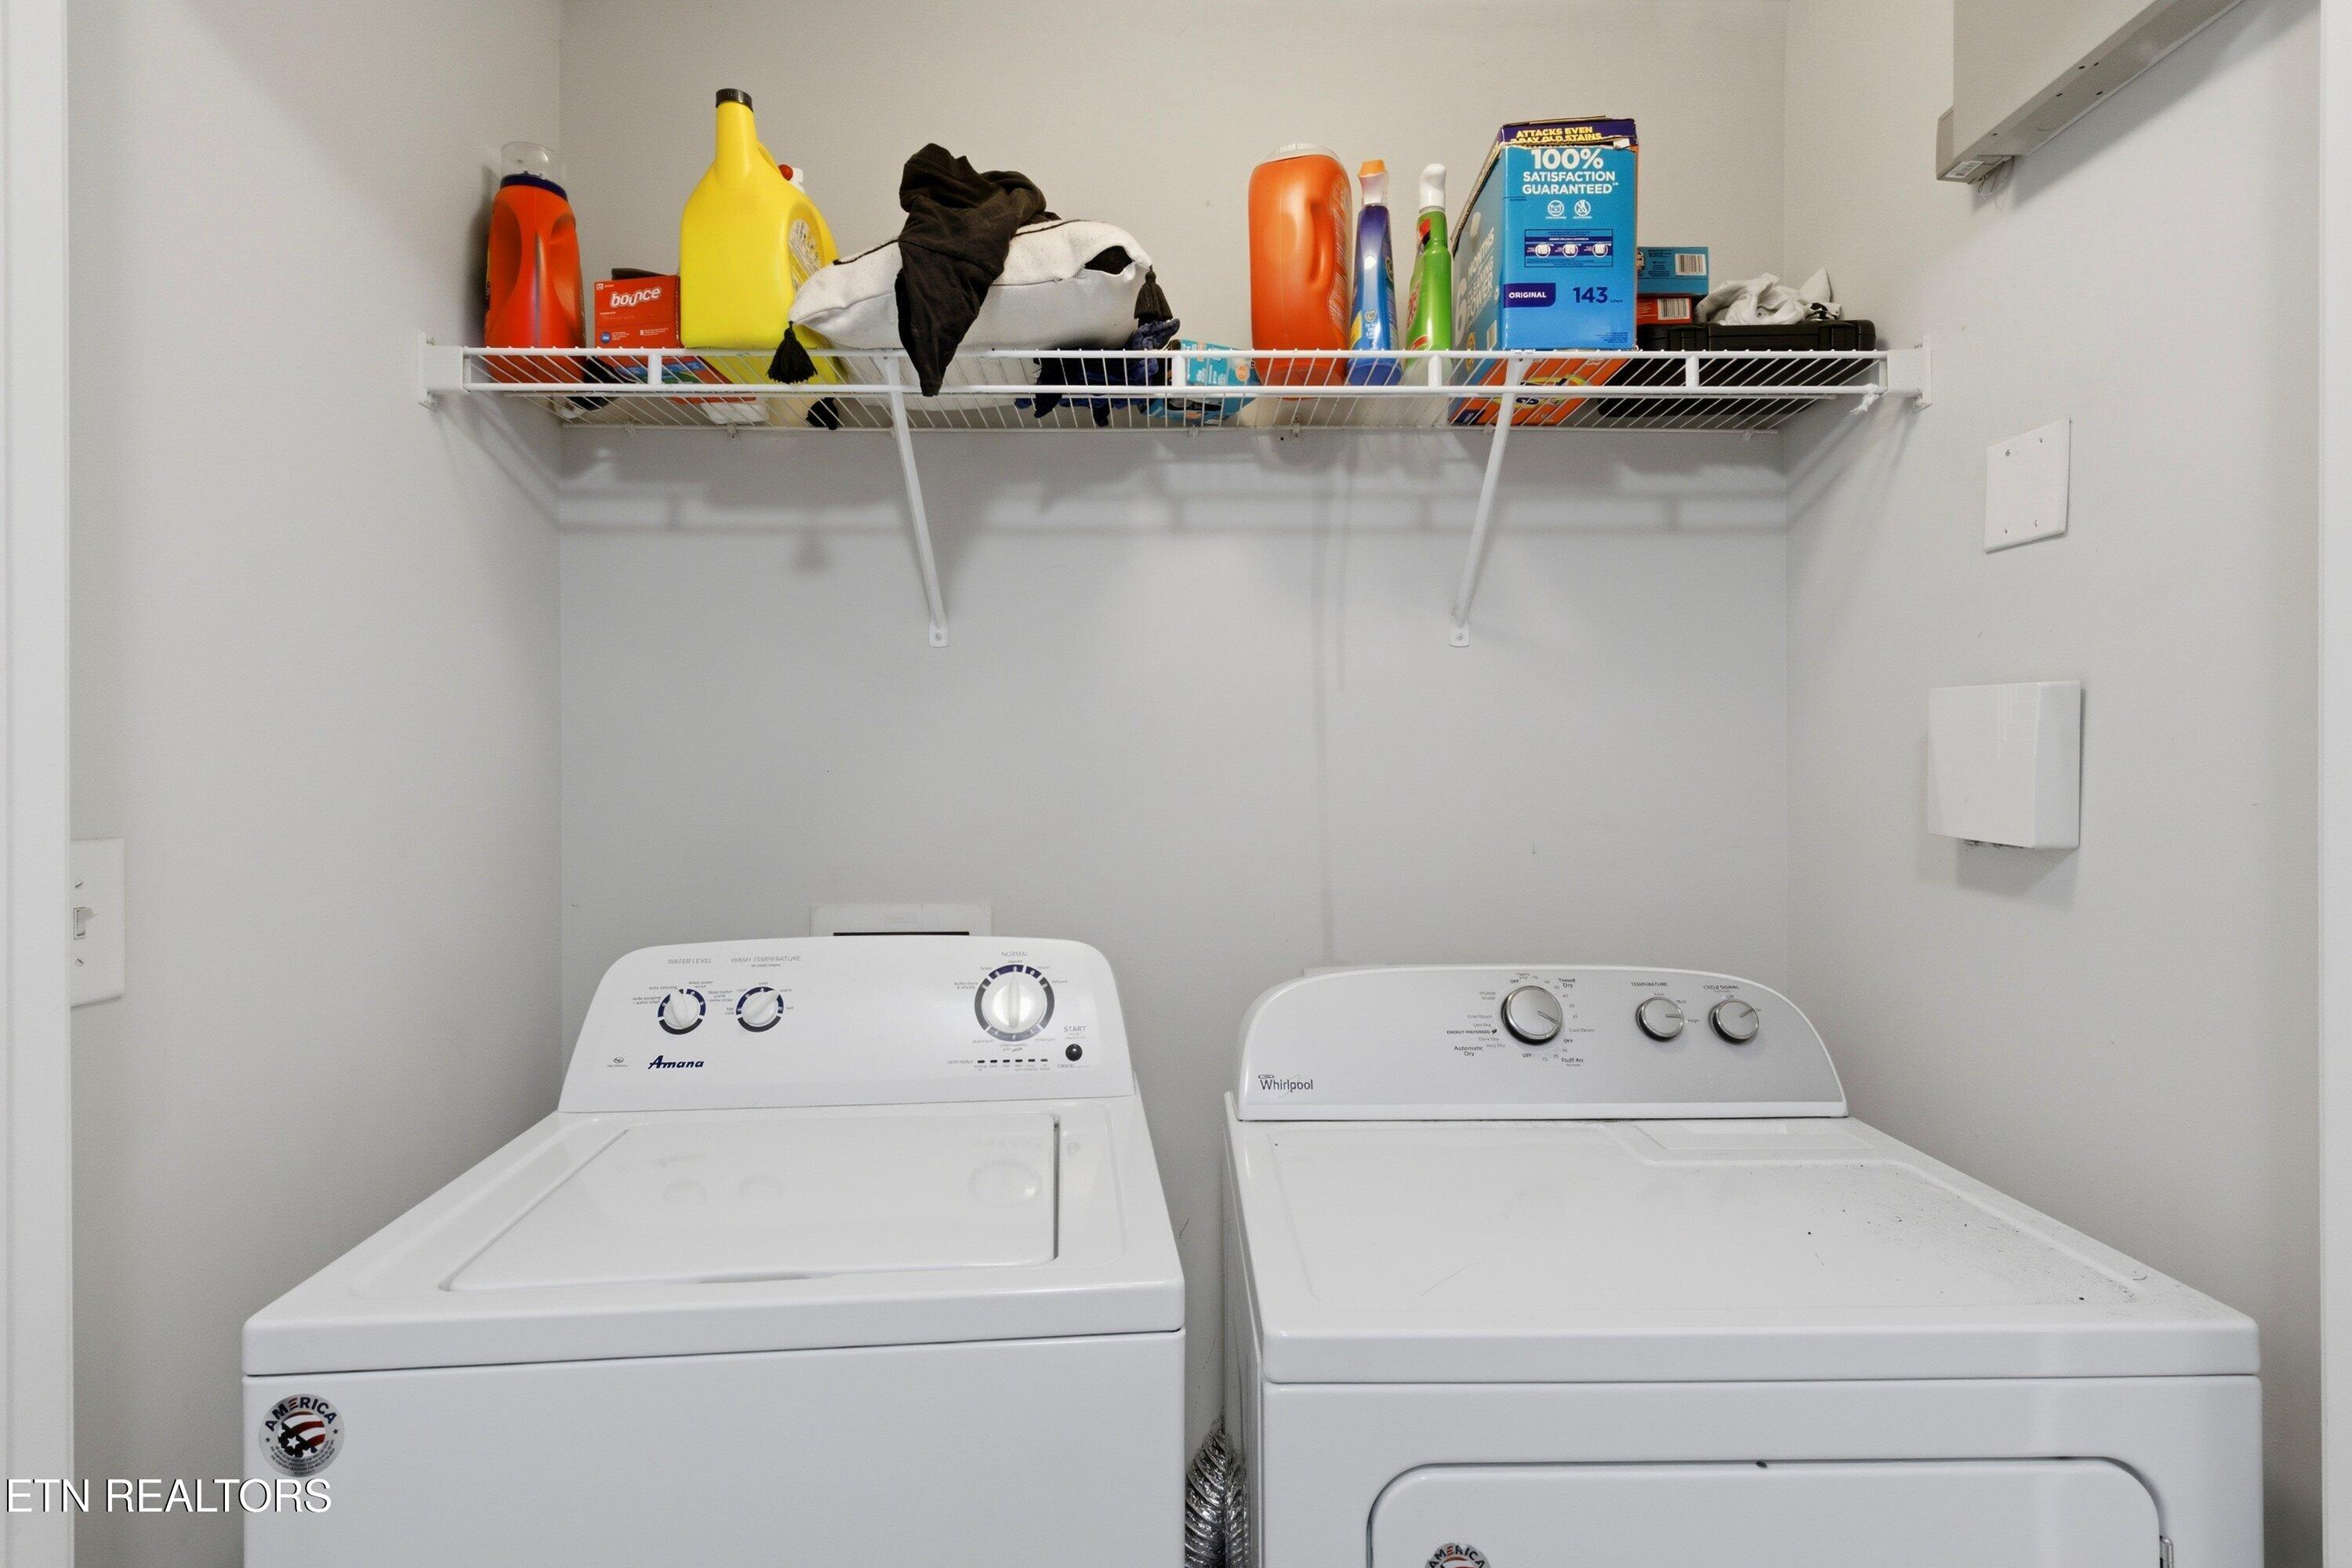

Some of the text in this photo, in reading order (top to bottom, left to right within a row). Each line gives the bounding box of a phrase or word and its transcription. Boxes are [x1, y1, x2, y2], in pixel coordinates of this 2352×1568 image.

[1516, 128, 1563, 138] ATTACKS
[1531, 148, 1604, 169] 100%
[1523, 171, 1616, 182] SATISFACTION
[611, 287, 662, 308] bounce
[1573, 286, 1608, 303] 143
[648, 1054, 705, 1069] Amana
[1259, 1079, 1313, 1093] Whirlpool
[265, 1396, 337, 1432] AMERICA
[1428, 1544, 1486, 1568] AMERICA
